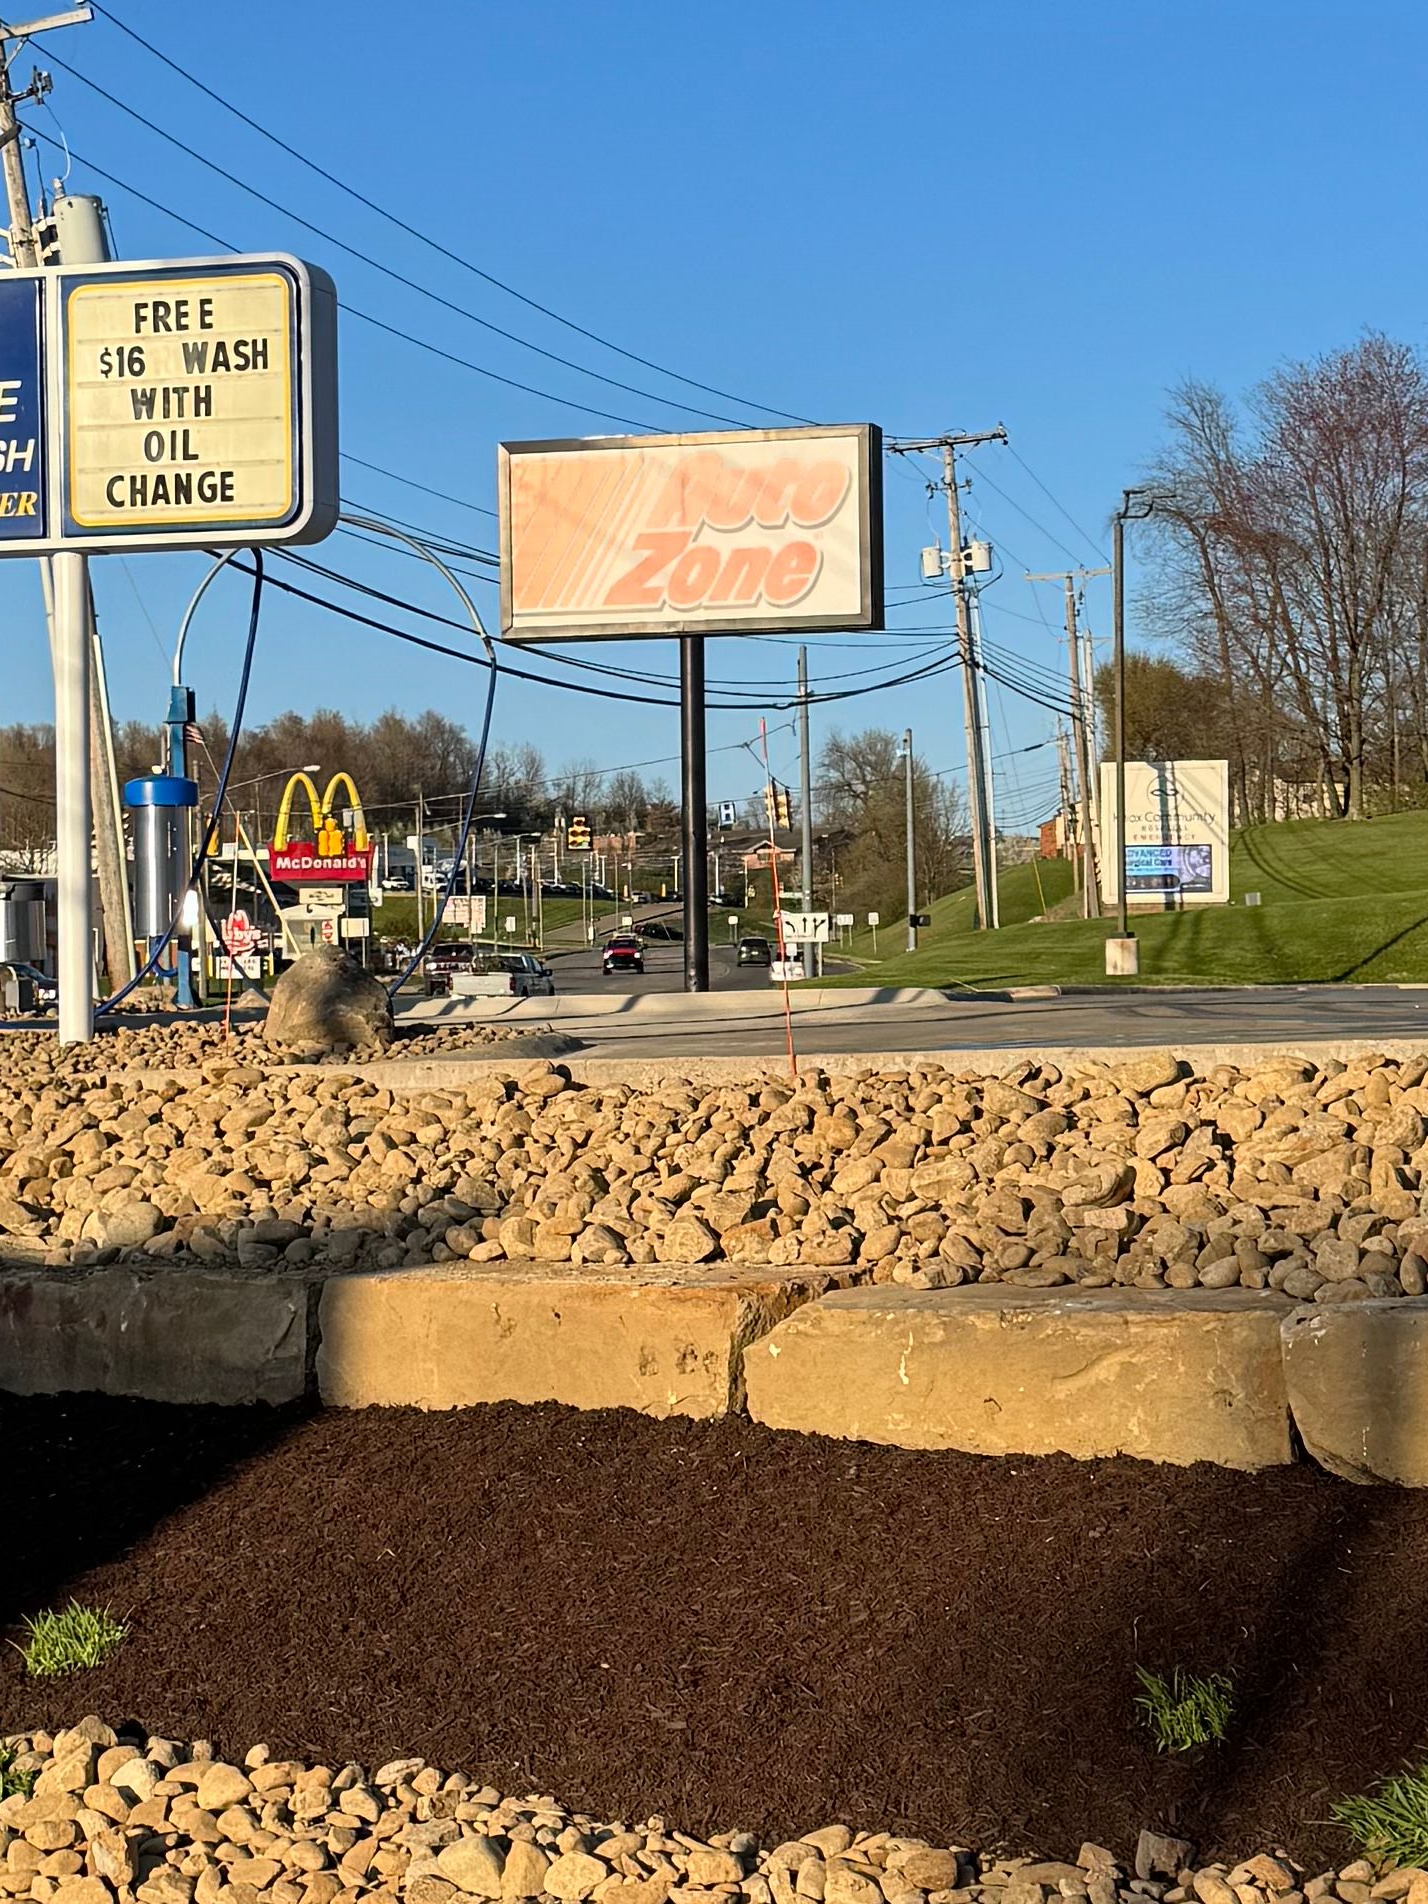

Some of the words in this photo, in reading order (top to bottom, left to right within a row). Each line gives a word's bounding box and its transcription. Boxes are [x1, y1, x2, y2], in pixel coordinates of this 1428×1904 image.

[134, 298, 214, 334] FREE
[99, 346, 146, 379] $16
[182, 338, 269, 375] WASH
[130, 385, 213, 421] WITH
[143, 429, 199, 463] OIL
[106, 470, 235, 508] CHANGE
[603, 530, 822, 608] Zone
[276, 856, 367, 869] McDonald's
